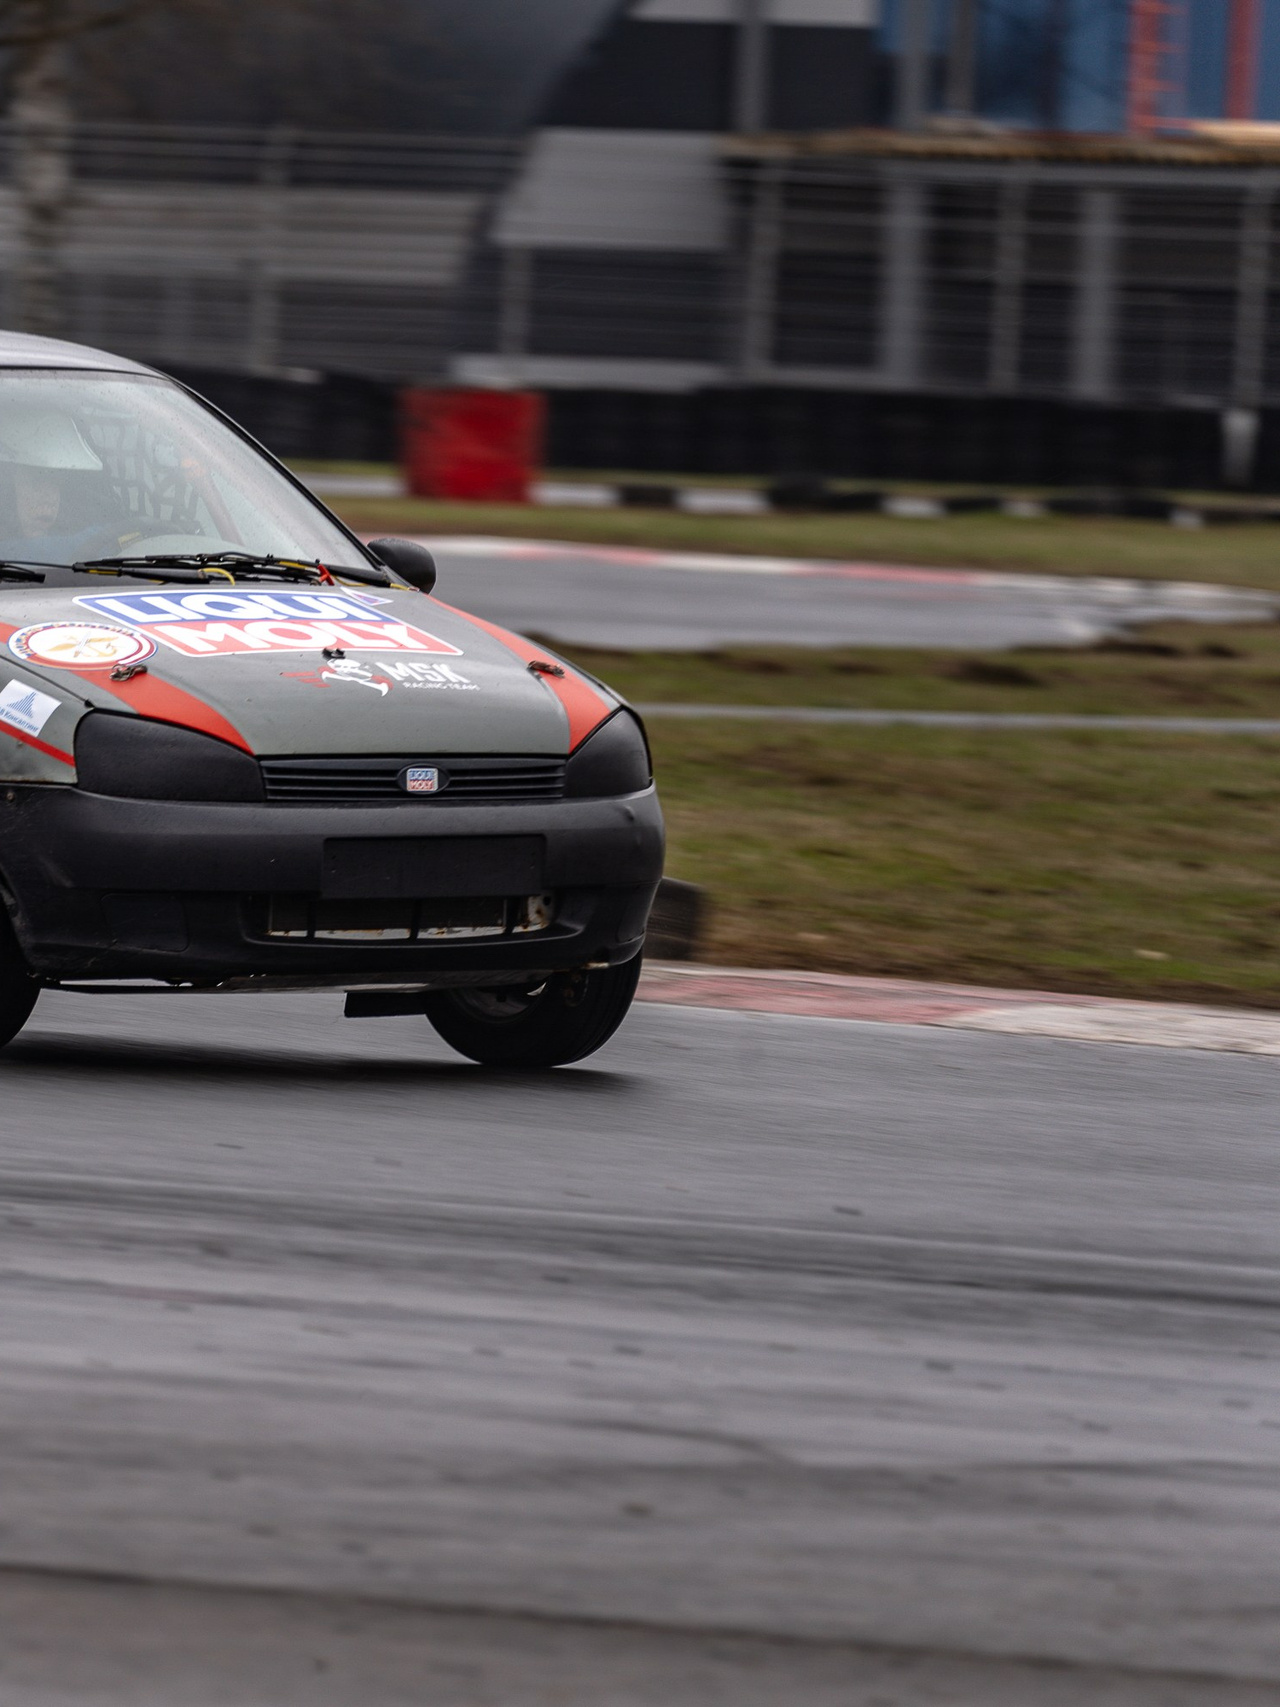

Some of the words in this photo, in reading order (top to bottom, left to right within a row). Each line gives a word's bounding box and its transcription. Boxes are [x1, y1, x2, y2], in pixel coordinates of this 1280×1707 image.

[94, 594, 383, 622] LIQUI
[154, 621, 428, 653] MOLY
[375, 661, 471, 684] MSK
[409, 780, 434, 790] MOLY
